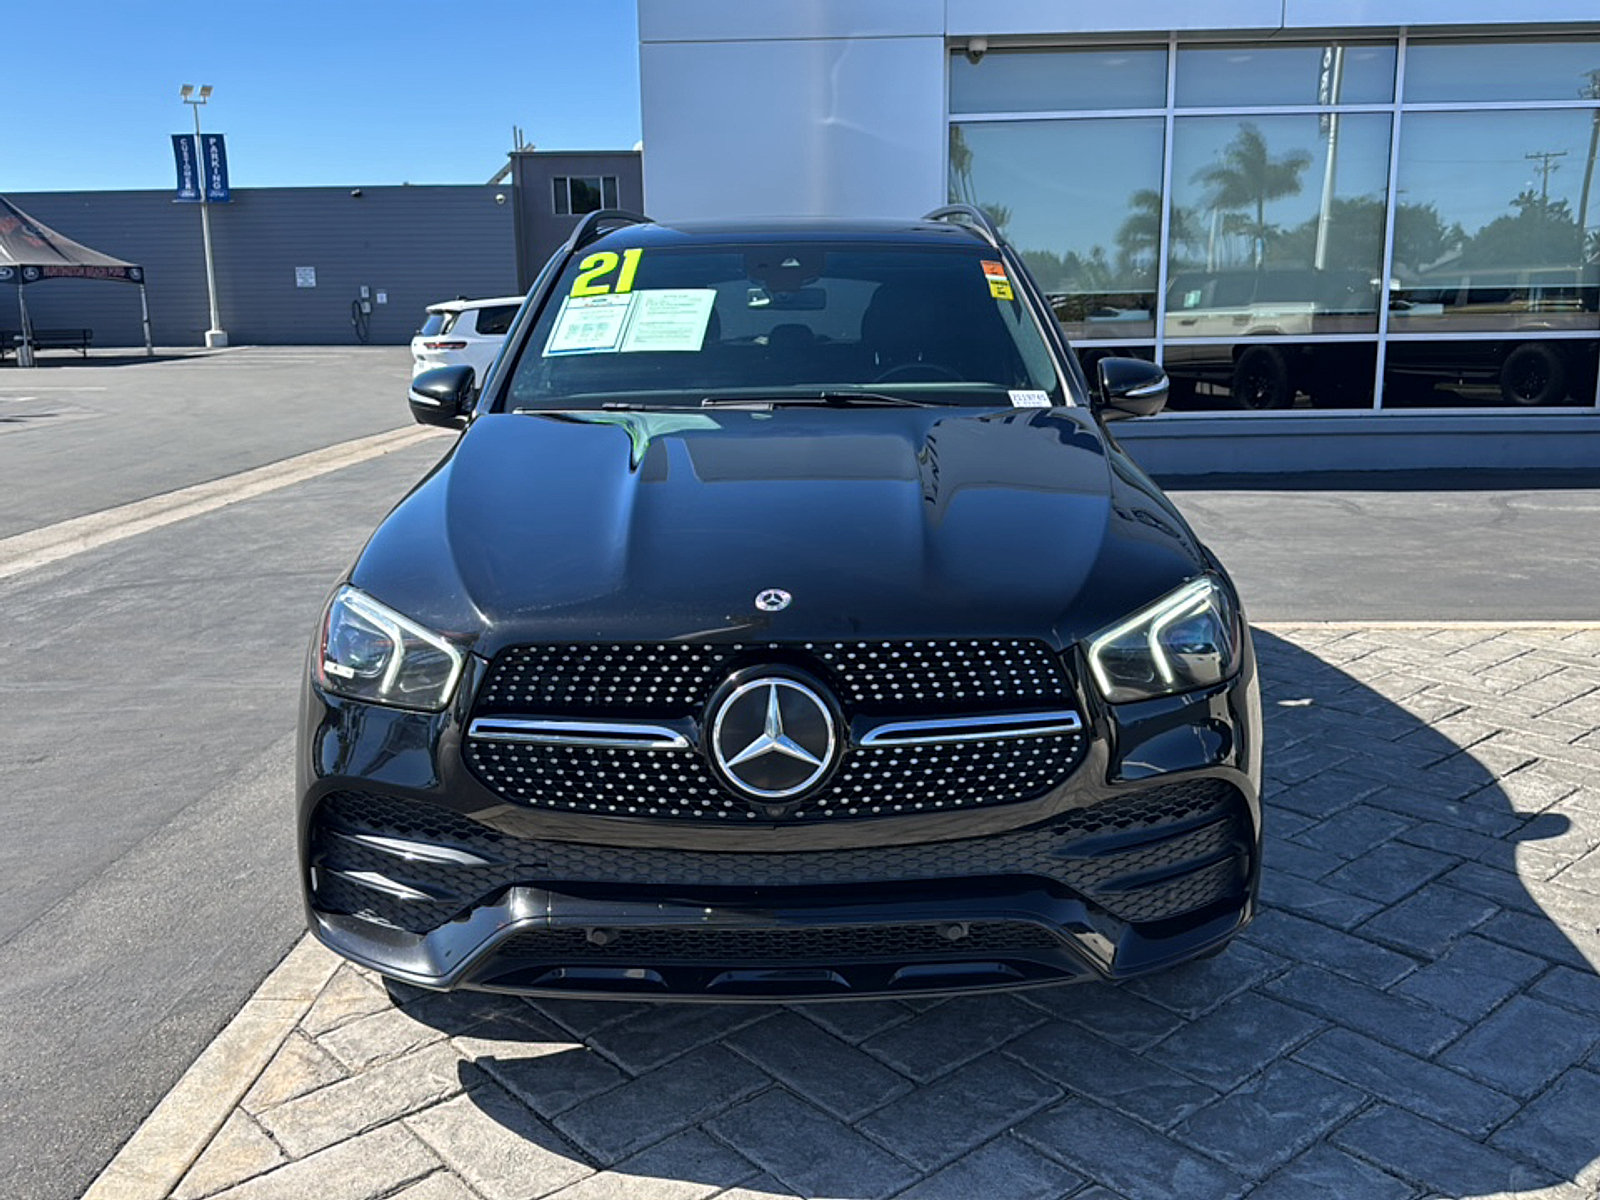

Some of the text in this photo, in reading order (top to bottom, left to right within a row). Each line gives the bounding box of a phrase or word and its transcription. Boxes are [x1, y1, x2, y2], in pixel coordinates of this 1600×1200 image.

[180, 138, 191, 189] CUSTOMER
[209, 137, 221, 189] PARKING
[570, 248, 643, 297] 21
